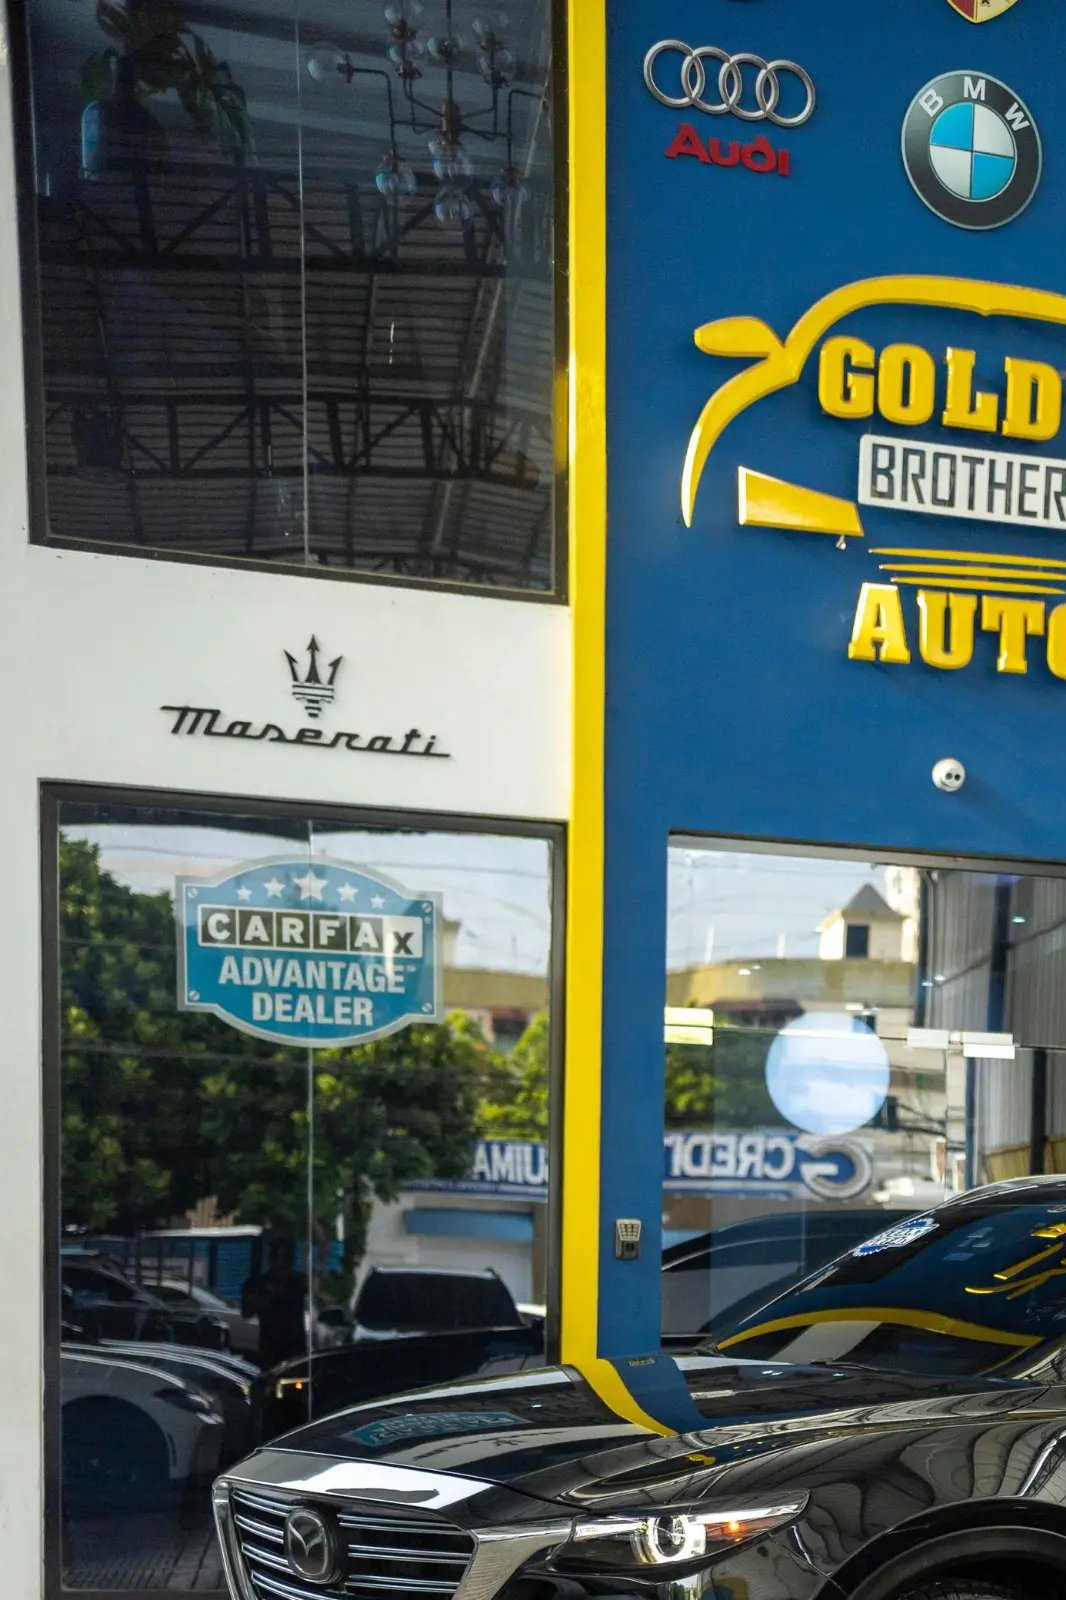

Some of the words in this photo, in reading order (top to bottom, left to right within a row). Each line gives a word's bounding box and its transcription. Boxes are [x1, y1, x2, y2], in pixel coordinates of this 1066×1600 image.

[919, 76, 1030, 132] BMW
[664, 123, 790, 177] Audi
[160, 704, 451, 758] Maserati
[205, 912, 414, 955] CARFAX
[218, 956, 406, 994] ADVANTAGE
[251, 993, 375, 1028] DEALER
